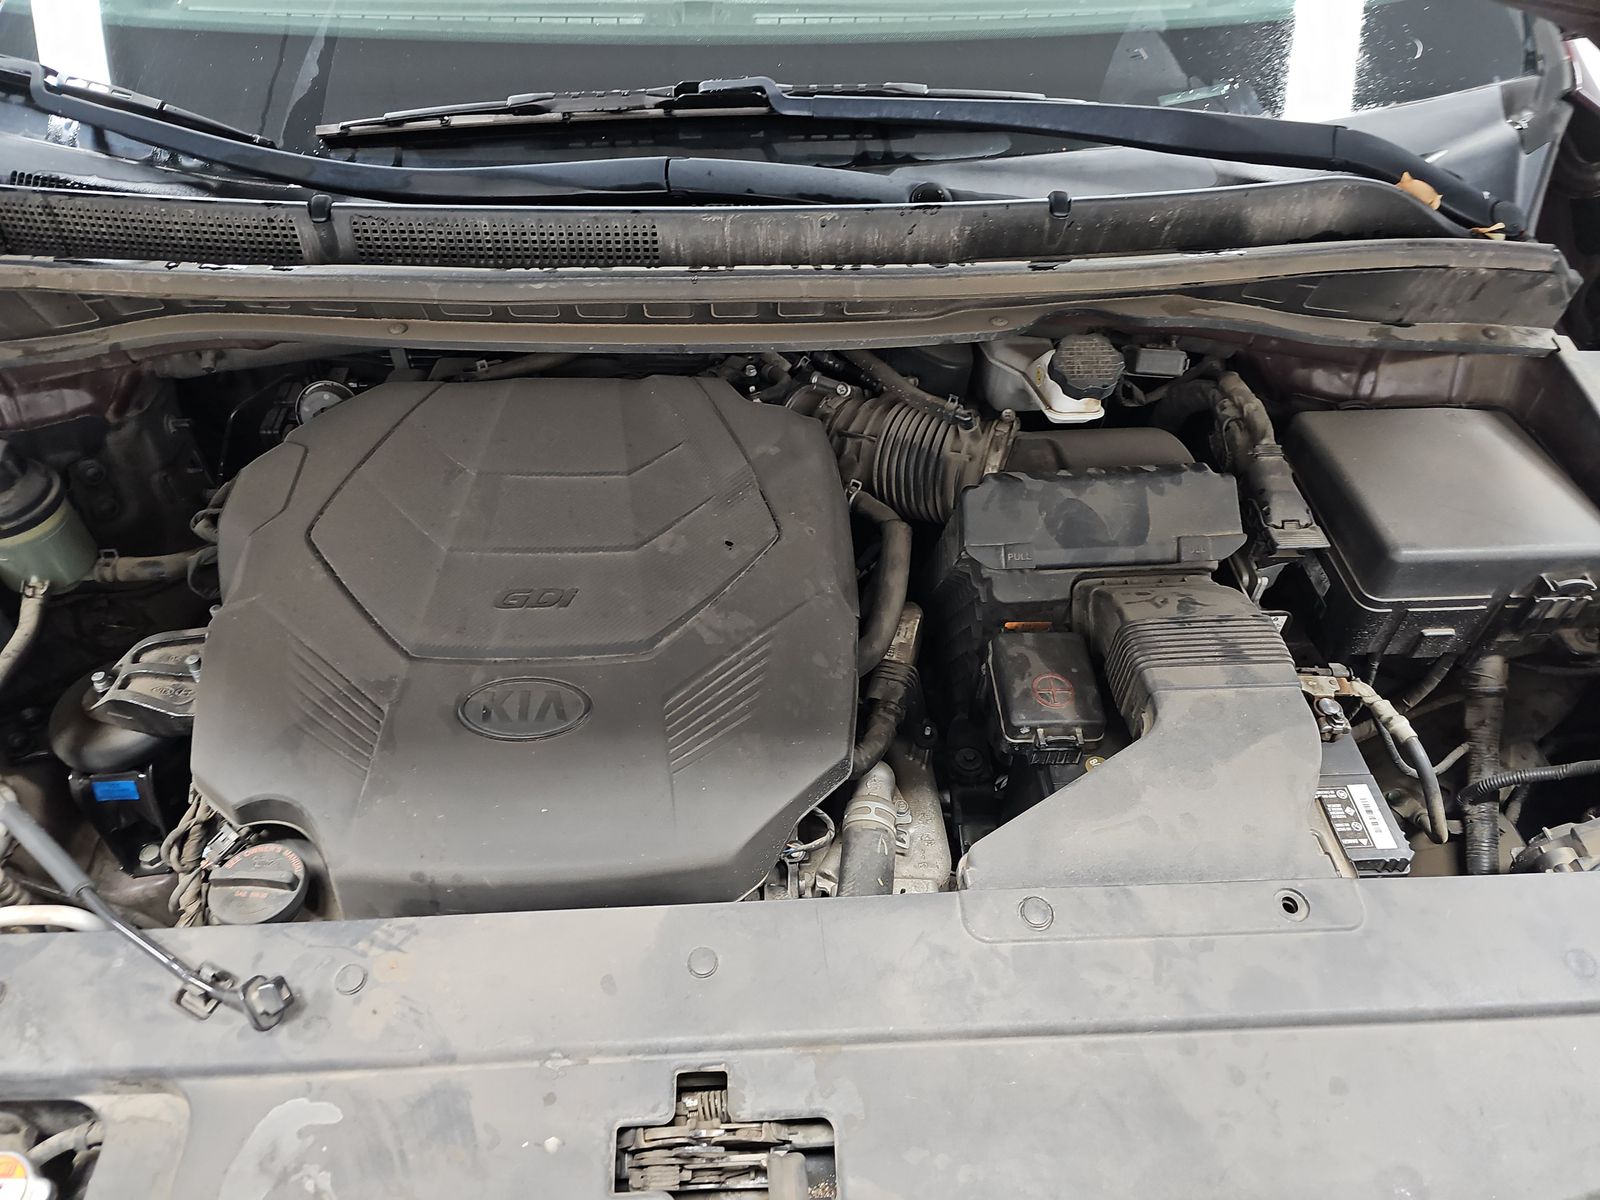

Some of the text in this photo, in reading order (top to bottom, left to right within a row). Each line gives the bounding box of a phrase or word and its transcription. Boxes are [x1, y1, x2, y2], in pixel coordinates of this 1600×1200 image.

[1007, 552, 1033, 562] PULL
[494, 587, 580, 610] GDI
[481, 689, 569, 723] KIA
